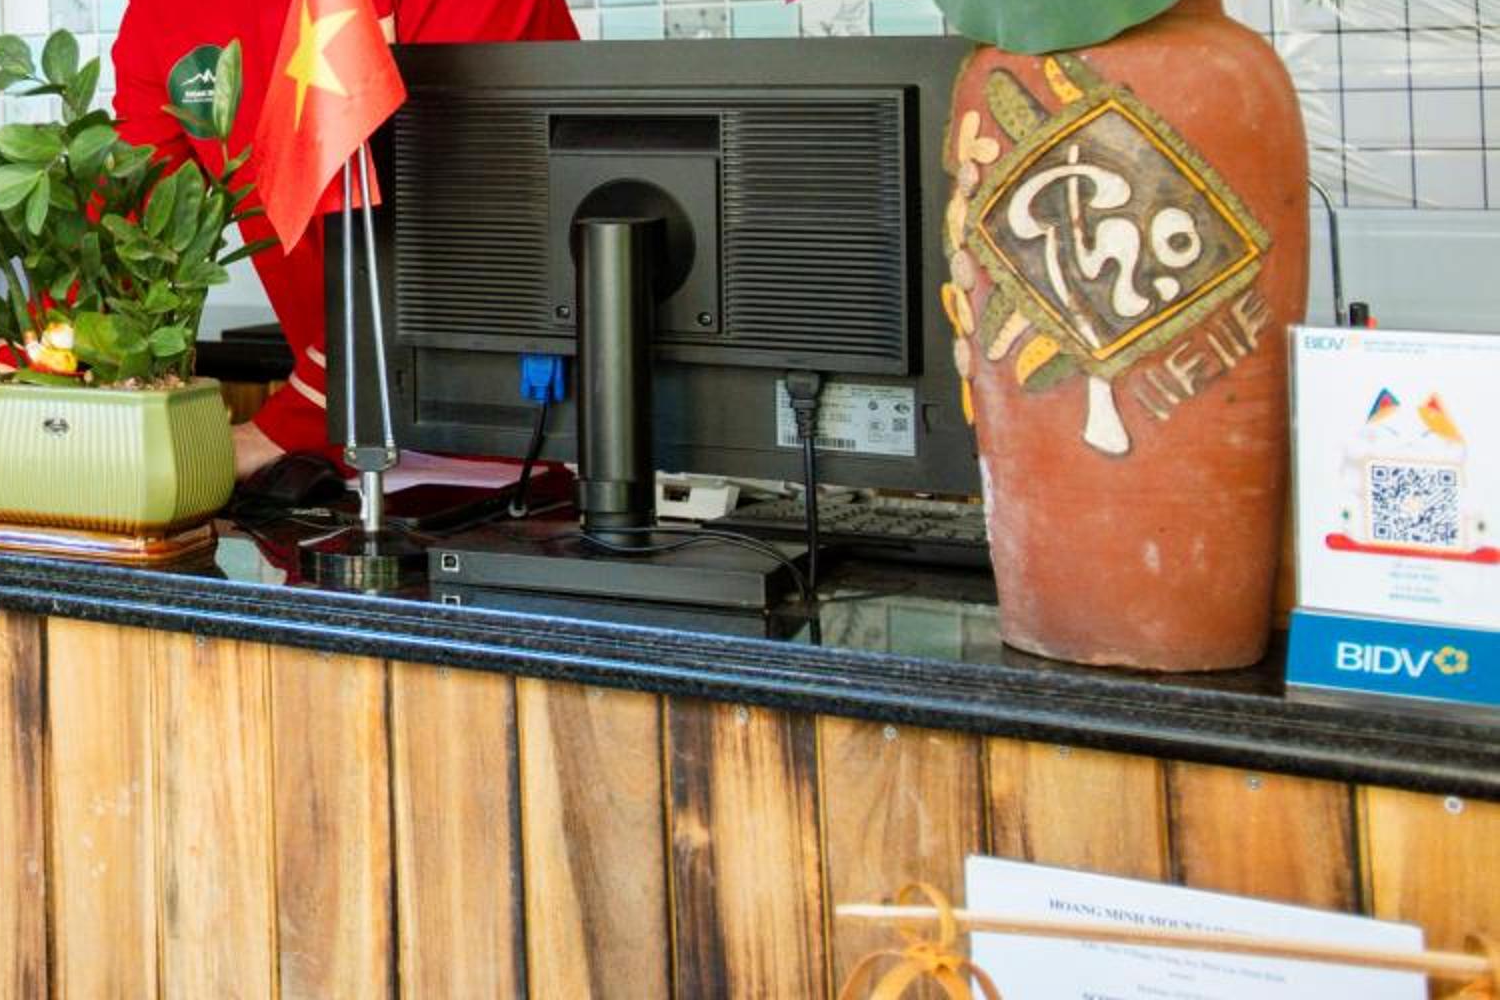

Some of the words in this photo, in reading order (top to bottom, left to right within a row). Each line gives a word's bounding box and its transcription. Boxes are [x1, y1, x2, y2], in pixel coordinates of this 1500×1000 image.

[1336, 641, 1434, 678] BIDV
[1049, 899, 1102, 917] HOANG
[1105, 908, 1145, 925] MINH
